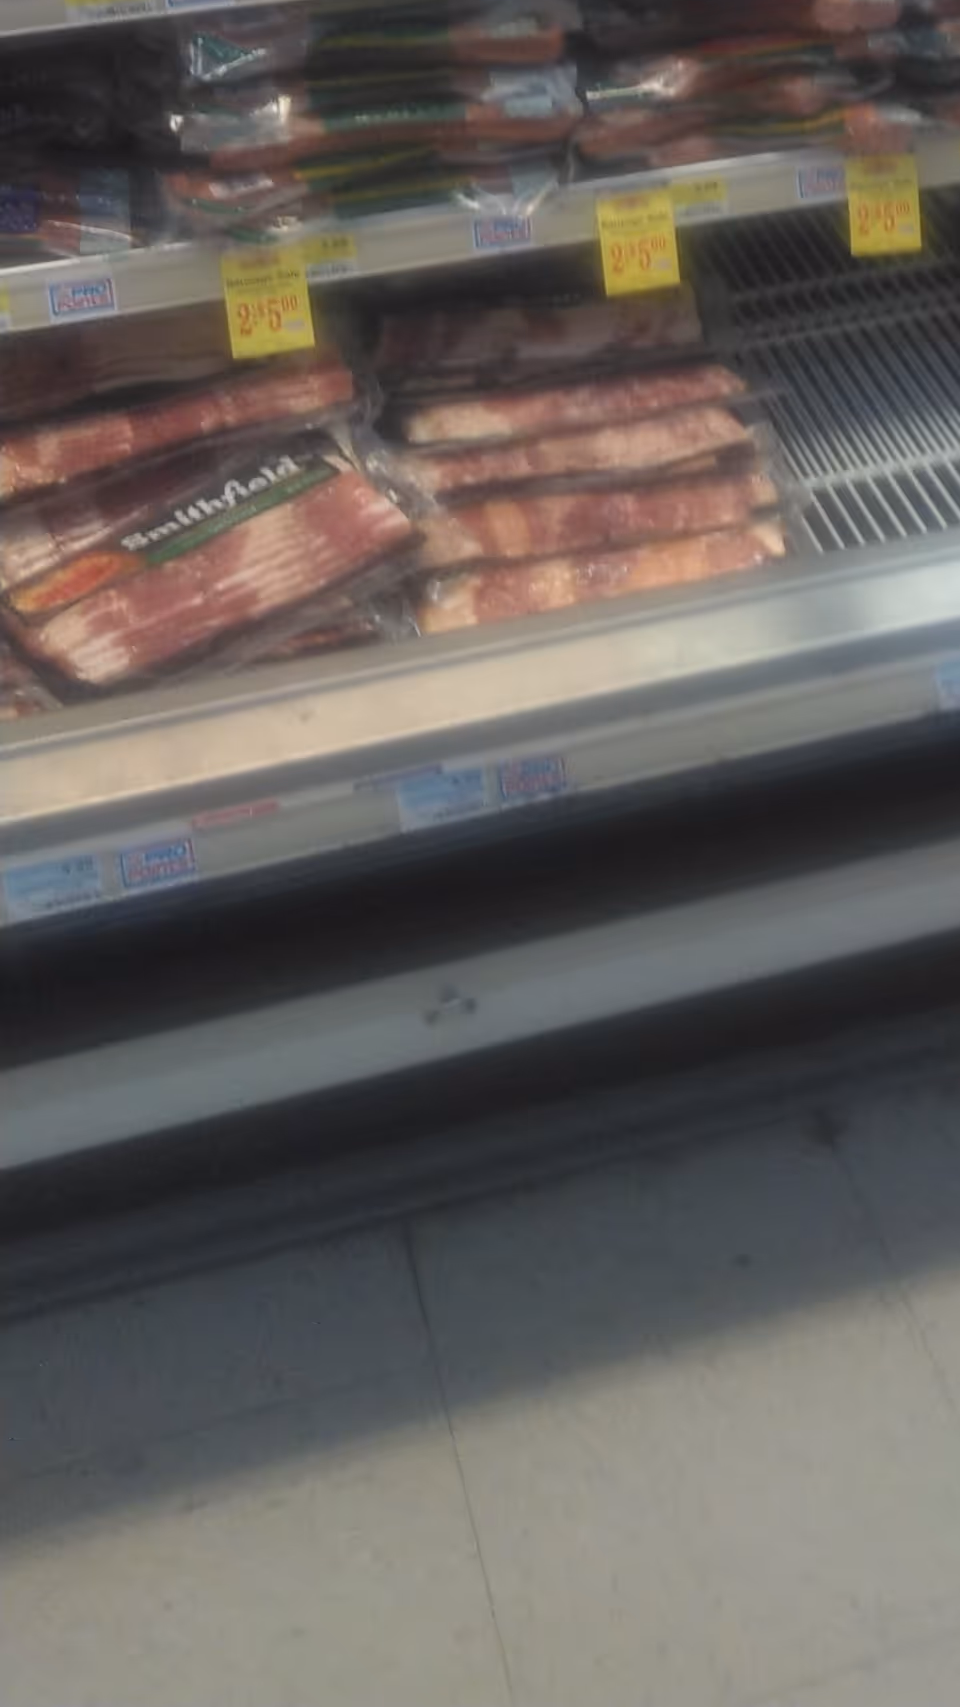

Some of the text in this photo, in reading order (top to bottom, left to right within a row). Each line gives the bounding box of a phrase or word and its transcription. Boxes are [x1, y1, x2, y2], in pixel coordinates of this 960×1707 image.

[610, 242, 625, 275] 2
[238, 302, 254, 336] 2
[120, 453, 301, 552] Smithfield
[141, 844, 188, 862] PRO
